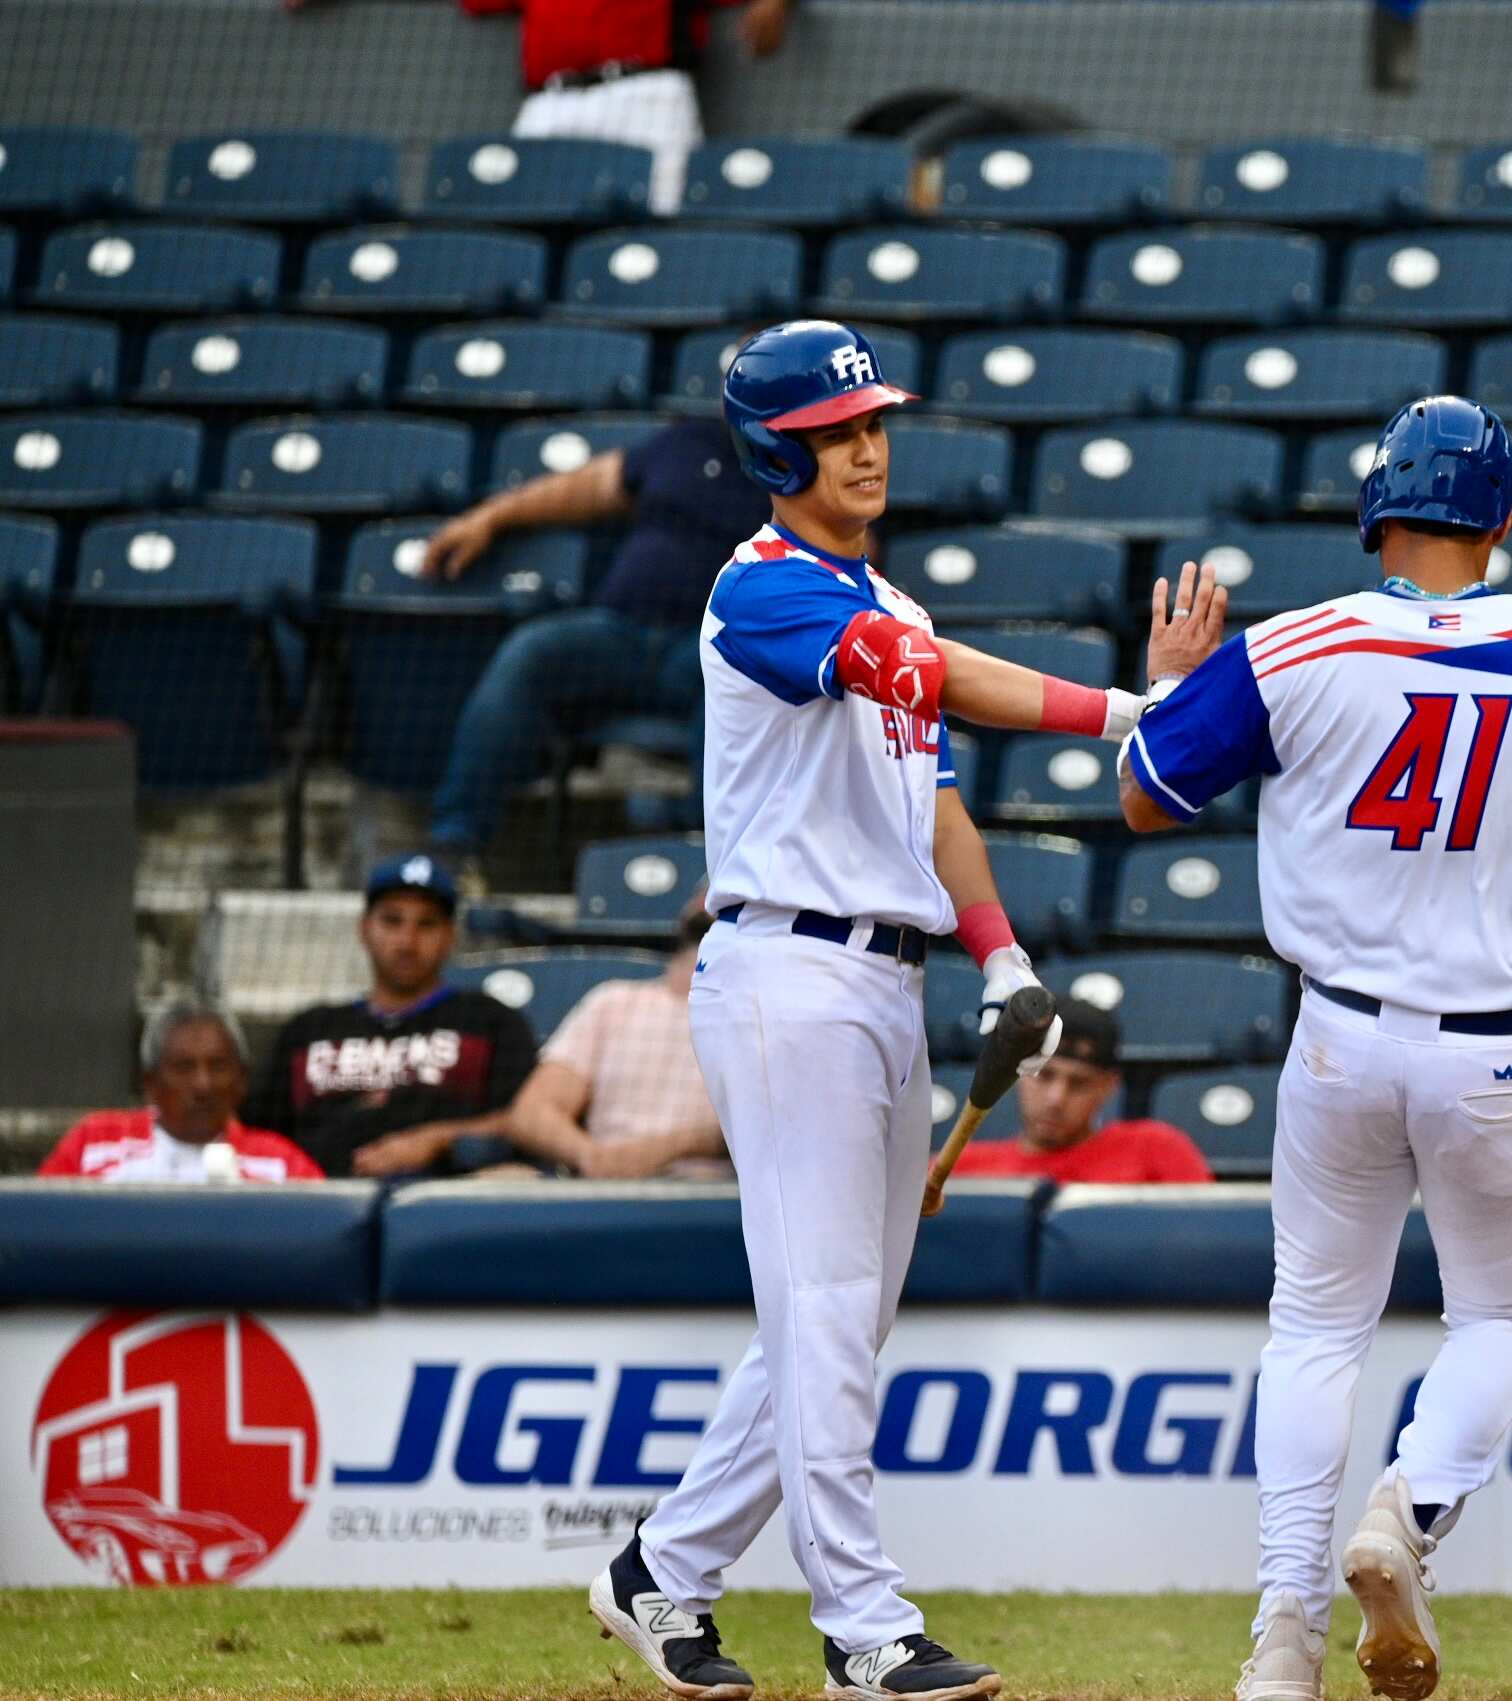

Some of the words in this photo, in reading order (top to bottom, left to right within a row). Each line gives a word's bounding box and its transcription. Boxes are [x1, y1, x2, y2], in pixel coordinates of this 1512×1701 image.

[332, 1363, 720, 1487] JGE
[870, 1369, 1256, 1478] ORG
[327, 1505, 530, 1542] SOLUCIONES
